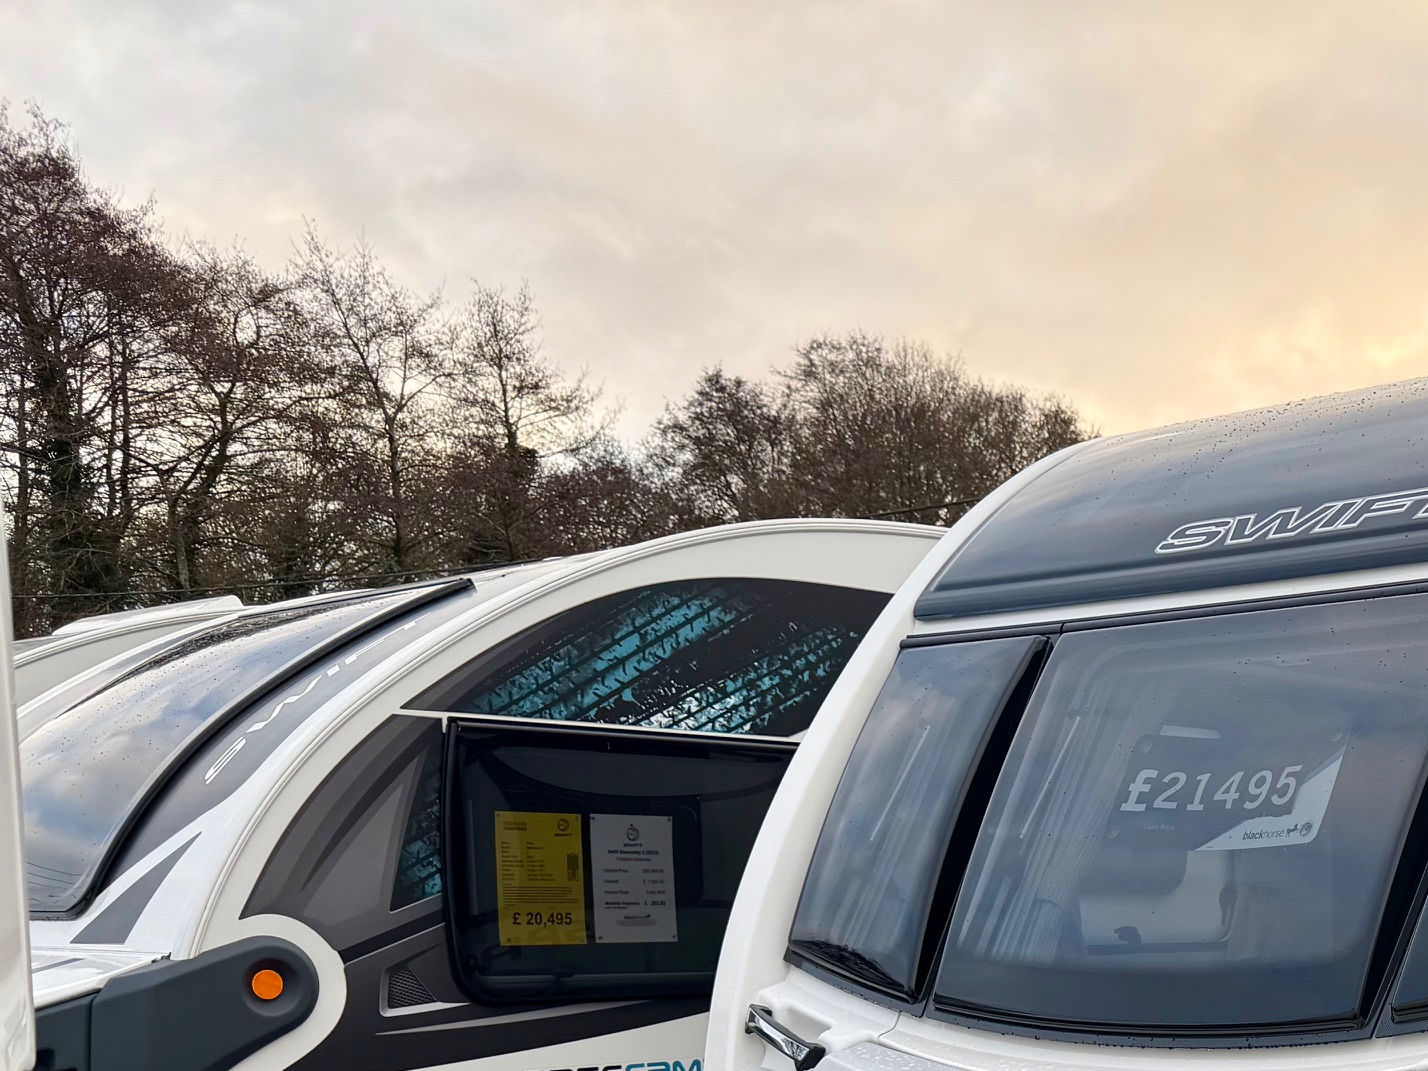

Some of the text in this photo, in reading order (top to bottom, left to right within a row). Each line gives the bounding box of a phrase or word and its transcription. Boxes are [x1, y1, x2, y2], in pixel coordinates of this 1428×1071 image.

[1120, 764, 1302, 812] £21495
[1242, 829, 1285, 841] blackhorse
[512, 911, 573, 928] £ 20,495
